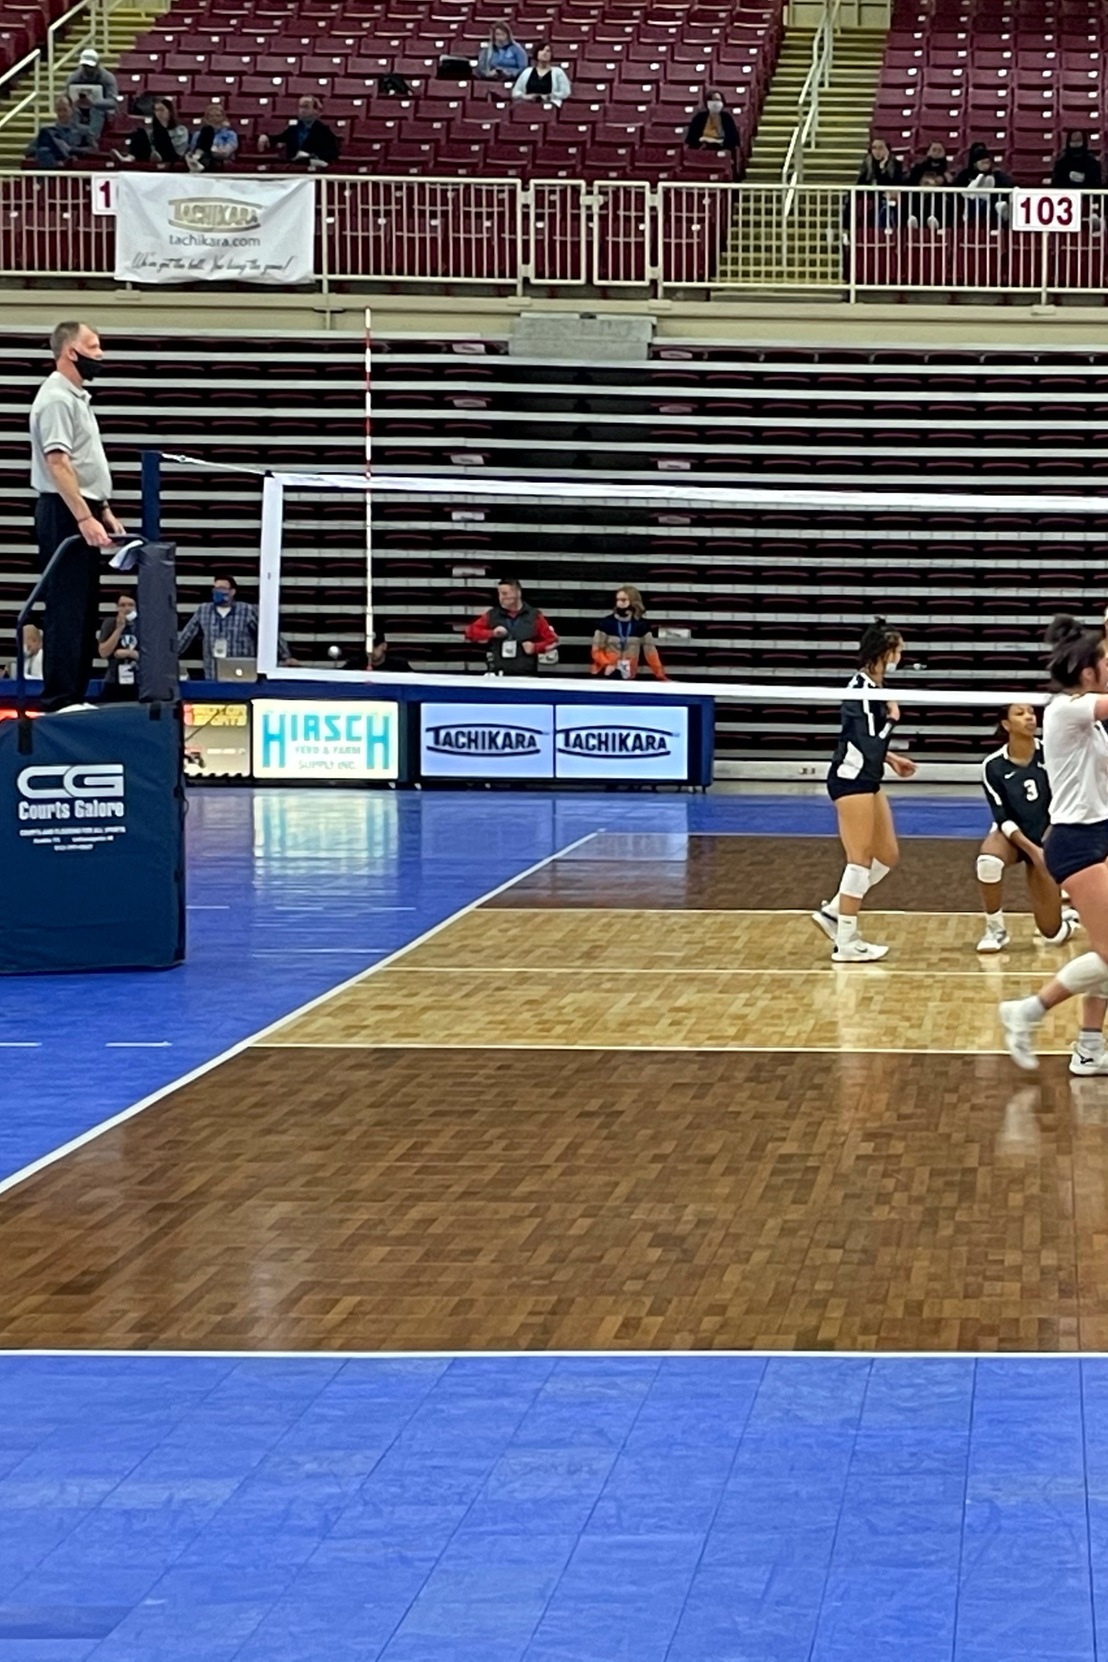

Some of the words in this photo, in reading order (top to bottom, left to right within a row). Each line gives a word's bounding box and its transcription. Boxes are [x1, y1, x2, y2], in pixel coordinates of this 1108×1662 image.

[171, 199, 260, 227] TACHIKARA
[1020, 196, 1073, 226] 103
[169, 234, 261, 248] tachikara.com
[262, 713, 390, 770] HIRSCH
[430, 727, 537, 751] TACHIKARA
[558, 728, 668, 752] TACHIKARA
[17, 763, 124, 799] CG
[1023, 779, 1039, 801] 3
[18, 801, 71, 820] Courts
[74, 799, 124, 818] Galore
